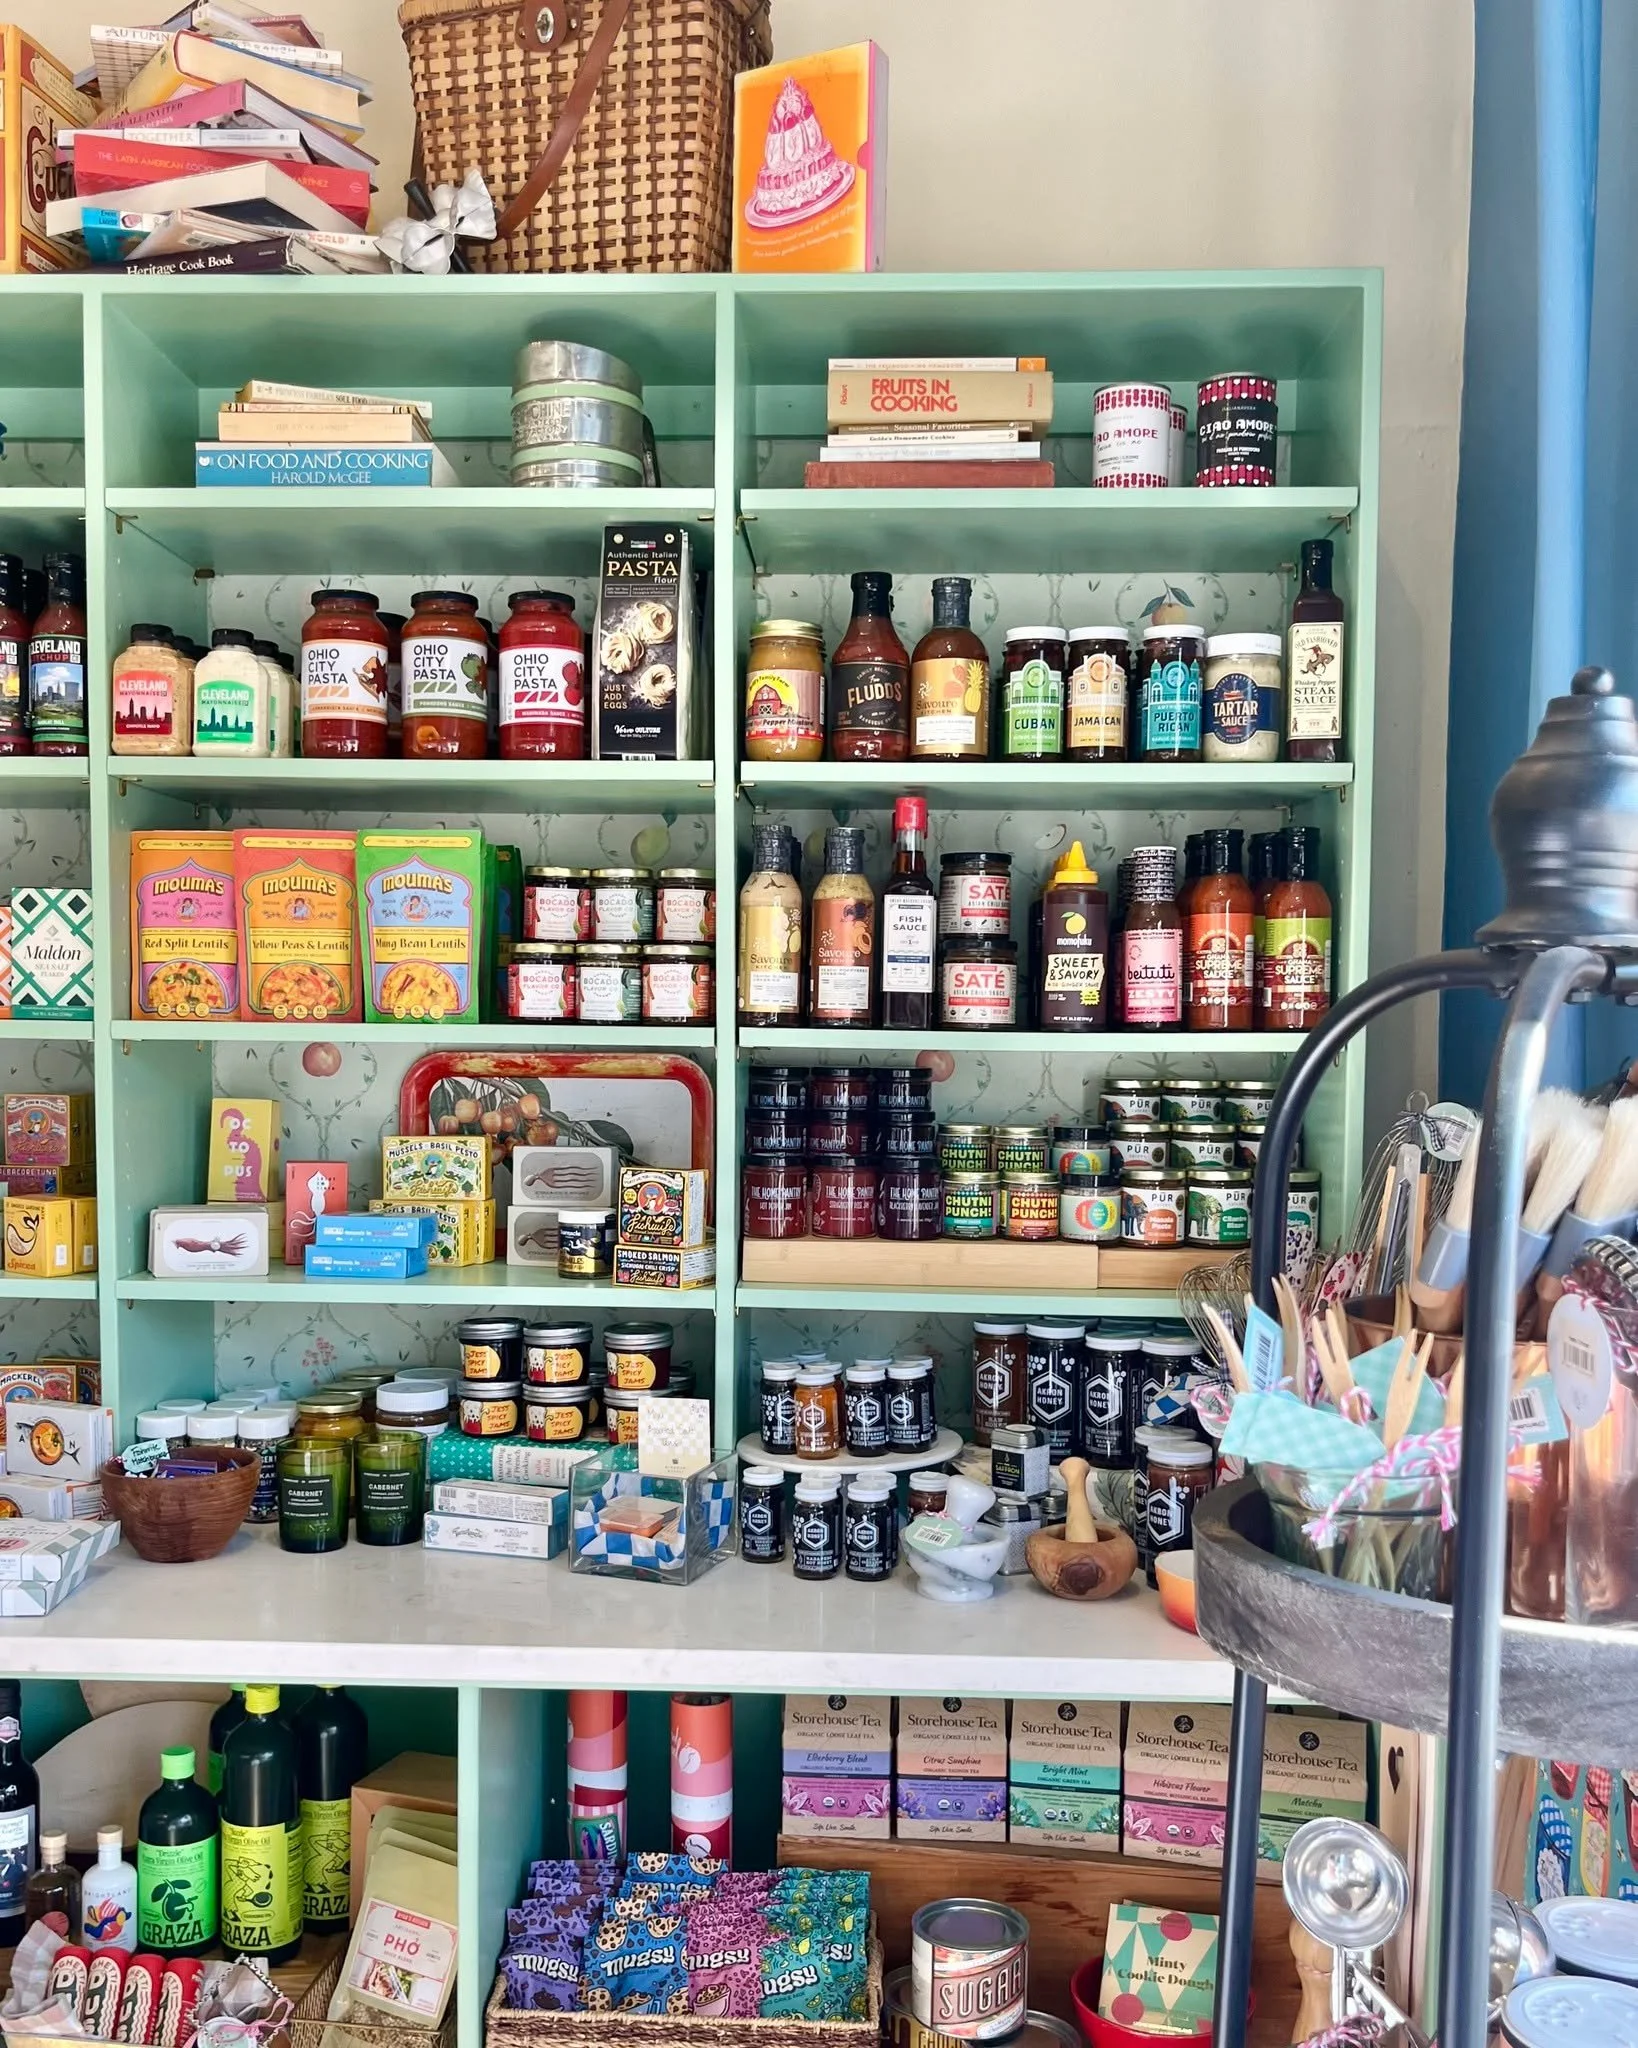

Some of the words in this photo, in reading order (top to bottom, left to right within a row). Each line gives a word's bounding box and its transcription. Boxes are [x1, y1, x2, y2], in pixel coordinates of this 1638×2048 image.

[108, 27, 170, 42] AUTUMN
[128, 131, 194, 143] TOGETHER
[115, 153, 137, 166] LATIN
[140, 157, 184, 170] AMERICAN
[126, 259, 176, 275] Heritage
[179, 258, 205, 271] Cook
[207, 254, 234, 268] Book
[871, 378, 928, 395] FRUITS
[931, 379, 950, 395] IN
[870, 395, 958, 412] COOKING
[894, 423, 931, 432] Seasonal
[1199, 419, 1231, 436] CIAO
[1235, 419, 1275, 435] AMORE
[1113, 428, 1158, 440] AMORE
[217, 453, 246, 470] ON
[249, 453, 299, 470] FOOD
[301, 453, 341, 469] AND
[341, 454, 428, 470] COOKING
[271, 471, 325, 485] HAROLD
[607, 551, 649, 559] Authentic
[651, 551, 678, 559] Italian
[606, 560, 679, 577] PASTA
[308, 649, 340, 661] OHIO
[413, 644, 448, 656] OHIO
[413, 656, 445, 668] CITY
[514, 654, 549, 666] OHIO
[308, 661, 337, 673] CITY
[514, 666, 545, 678] CITY
[308, 672, 348, 685] PASTA
[413, 668, 456, 681] PASTA
[119, 679, 168, 691] CLEVELAND
[514, 678, 557, 690] PASTA
[604, 684, 627, 692] JUST
[201, 689, 249, 701] CLEVELAND
[604, 693, 622, 701] ADD
[847, 682, 902, 709] FLUDDS
[1294, 687, 1336, 696] STEAK
[603, 701, 628, 709] EGGS
[1294, 695, 1337, 705] SAUCE
[1213, 701, 1258, 717] TARTAR
[1073, 716, 1122, 727] JAMAICAN
[1154, 712, 1195, 722] PUERTO
[1221, 716, 1248, 727] SAUCE
[1013, 717, 1056, 731] CUBAN
[1158, 722, 1191, 733] RICAN
[539, 898, 576, 907] BOCADO
[599, 898, 634, 907] BOCADO
[666, 899, 702, 908] BOCADO
[899, 915, 923, 923] FISH
[893, 923, 927, 932] SAUCE
[144, 938, 163, 950] Red
[165, 938, 189, 951] Split
[192, 938, 229, 949] Lentils
[252, 939, 280, 950] Yellow
[281, 940, 305, 951] Peas
[306, 941, 315, 949] &
[317, 939, 350, 951] Lentils
[401, 938, 426, 950] Bean
[428, 938, 467, 950] Lentils
[1056, 933, 1093, 948] momofuku
[23, 943, 82, 962] Maldon
[1053, 957, 1099, 968] SWEET
[1195, 959, 1242, 971] SUPREME
[1049, 969, 1056, 981] &
[1058, 969, 1100, 980] SAVORY
[1203, 969, 1235, 979] SAUCE
[1274, 964, 1323, 975] SUPREME
[523, 975, 560, 983] BOCADO
[583, 977, 619, 985] BOCADO
[653, 974, 689, 982] BOCADO
[954, 970, 1005, 989] SATÉ
[1284, 974, 1315, 985] SAUCE
[1127, 989, 1175, 998] ZESTY
[1130, 1098, 1150, 1109] PŪR
[1191, 1098, 1212, 1110] PŪR
[229, 1141, 250, 1154] TO
[388, 1142, 424, 1159] MUSSELS
[430, 1142, 452, 1151] BASIL
[455, 1147, 479, 1159] PESTO
[941, 1148, 988, 1159] CHUTNI
[1126, 1144, 1149, 1154] PŪR
[1199, 1144, 1221, 1155] PŪR
[997, 1150, 1044, 1160] CHUTNI
[223, 1165, 252, 1178] PUS
[945, 1195, 992, 1206] CHUTNI
[1011, 1196, 1057, 1208] CHUTNI
[1151, 1191, 1173, 1202] PŪR
[1226, 1191, 1246, 1201] PŪR
[945, 1207, 992, 1218] PUNCH!
[1011, 1207, 1057, 1218] PUNCH!
[617, 1249, 647, 1260] SMOKED
[647, 1251, 680, 1262] SALMON
[0, 1373, 42, 1386] MACKEREL
[624, 1377, 645, 1385] JAMS
[979, 1372, 1003, 1381] AKRON
[1037, 1387, 1063, 1396] AKRON
[1036, 1396, 1063, 1405] HONEY
[490, 1404, 509, 1412] JESS
[487, 1413, 507, 1421] SPICY
[554, 1411, 574, 1419] JESS
[489, 1421, 511, 1429] JAMS
[554, 1427, 574, 1435] JAMS
[287, 1489, 324, 1498] CABERNET
[792, 1713, 860, 1726] Storehouse
[860, 1714, 881, 1727] Tea
[907, 1714, 975, 1728] Storehouse
[976, 1716, 998, 1729] Tea
[797, 1731, 825, 1739] ORGANIC
[1021, 1721, 1090, 1739] Storehouse
[1090, 1726, 1113, 1740] Tea
[1026, 1740, 1054, 1749] ORGANIC
[1135, 1731, 1205, 1752] Storehouse
[1206, 1739, 1229, 1754] Tea
[846, 1753, 868, 1763] Blend
[923, 1755, 946, 1765] Citrus
[947, 1756, 982, 1766] Sunshine
[1263, 1750, 1333, 1770] Storehouse
[1334, 1757, 1358, 1772] Tea
[1041, 1764, 1067, 1777] Bright
[1068, 1766, 1089, 1776] Mint
[1184, 1781, 1211, 1794] Flower
[1290, 1797, 1323, 1809] Matcha
[143, 1919, 205, 1945] GRAZA
[600, 1945, 676, 1978] mugsy
[1147, 1955, 1188, 1973] Minty
[510, 1953, 580, 1983] mugsy
[1117, 1967, 1166, 1983] Cookie
[1167, 1972, 1215, 1992] Dough
[939, 1955, 1023, 2020] SUGAR
